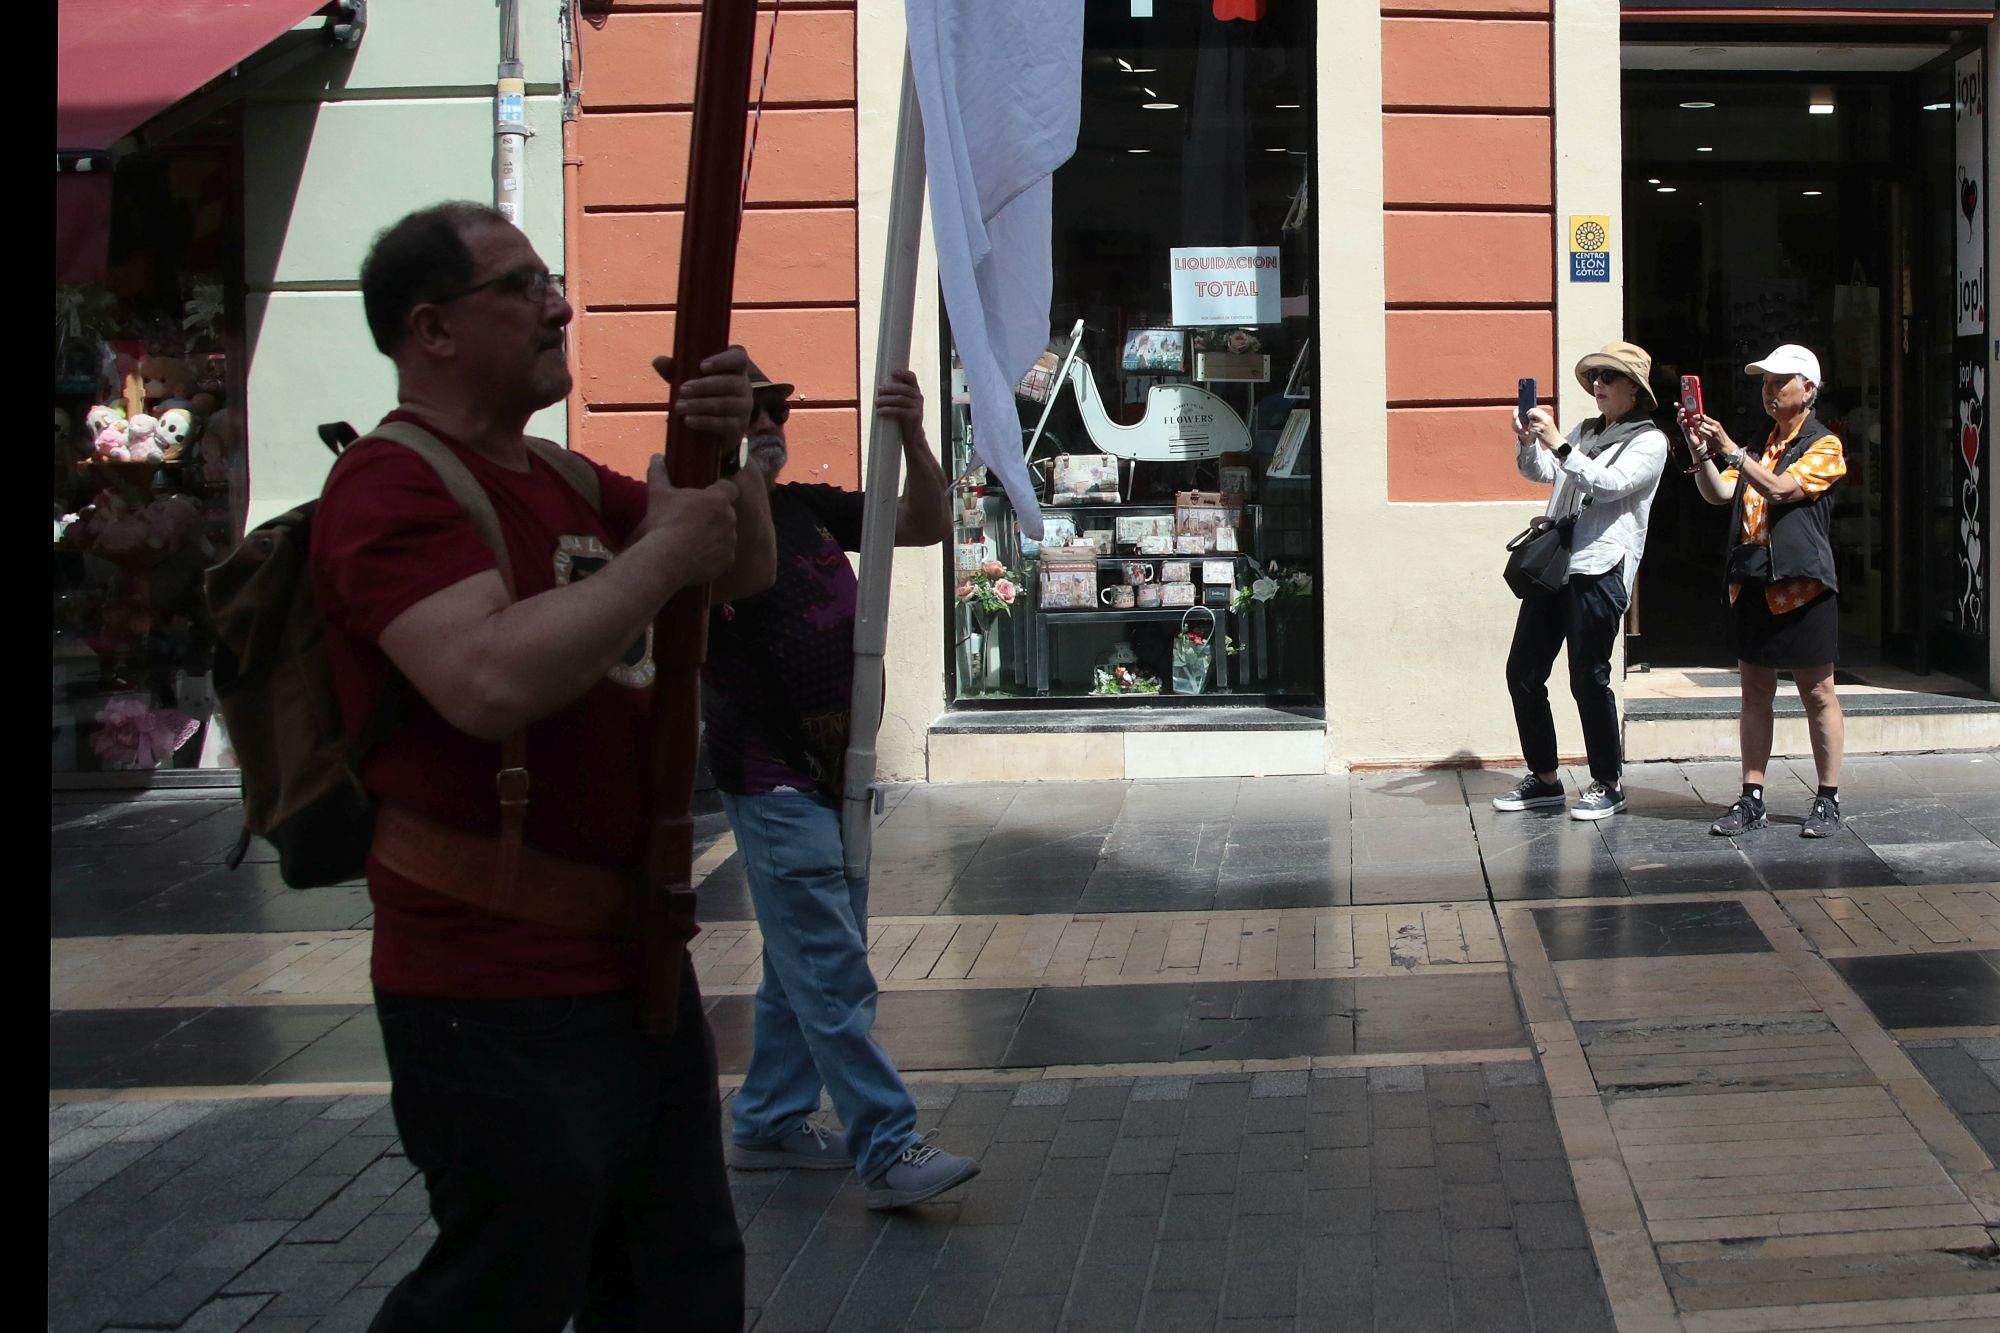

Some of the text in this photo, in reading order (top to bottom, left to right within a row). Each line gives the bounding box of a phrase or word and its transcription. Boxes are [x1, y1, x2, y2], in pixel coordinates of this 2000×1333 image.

[1957, 59, 1983, 122] jop!
[1175, 256, 1277, 270] LIQUIDACION
[1575, 258, 1605, 269] LEÓN
[1575, 268, 1605, 276] GÓTICO
[1195, 281, 1258, 297] TOTAL
[1958, 266, 1985, 323] jop!
[1959, 361, 1974, 390] jop!
[1164, 414, 1213, 424] FLOWERS
